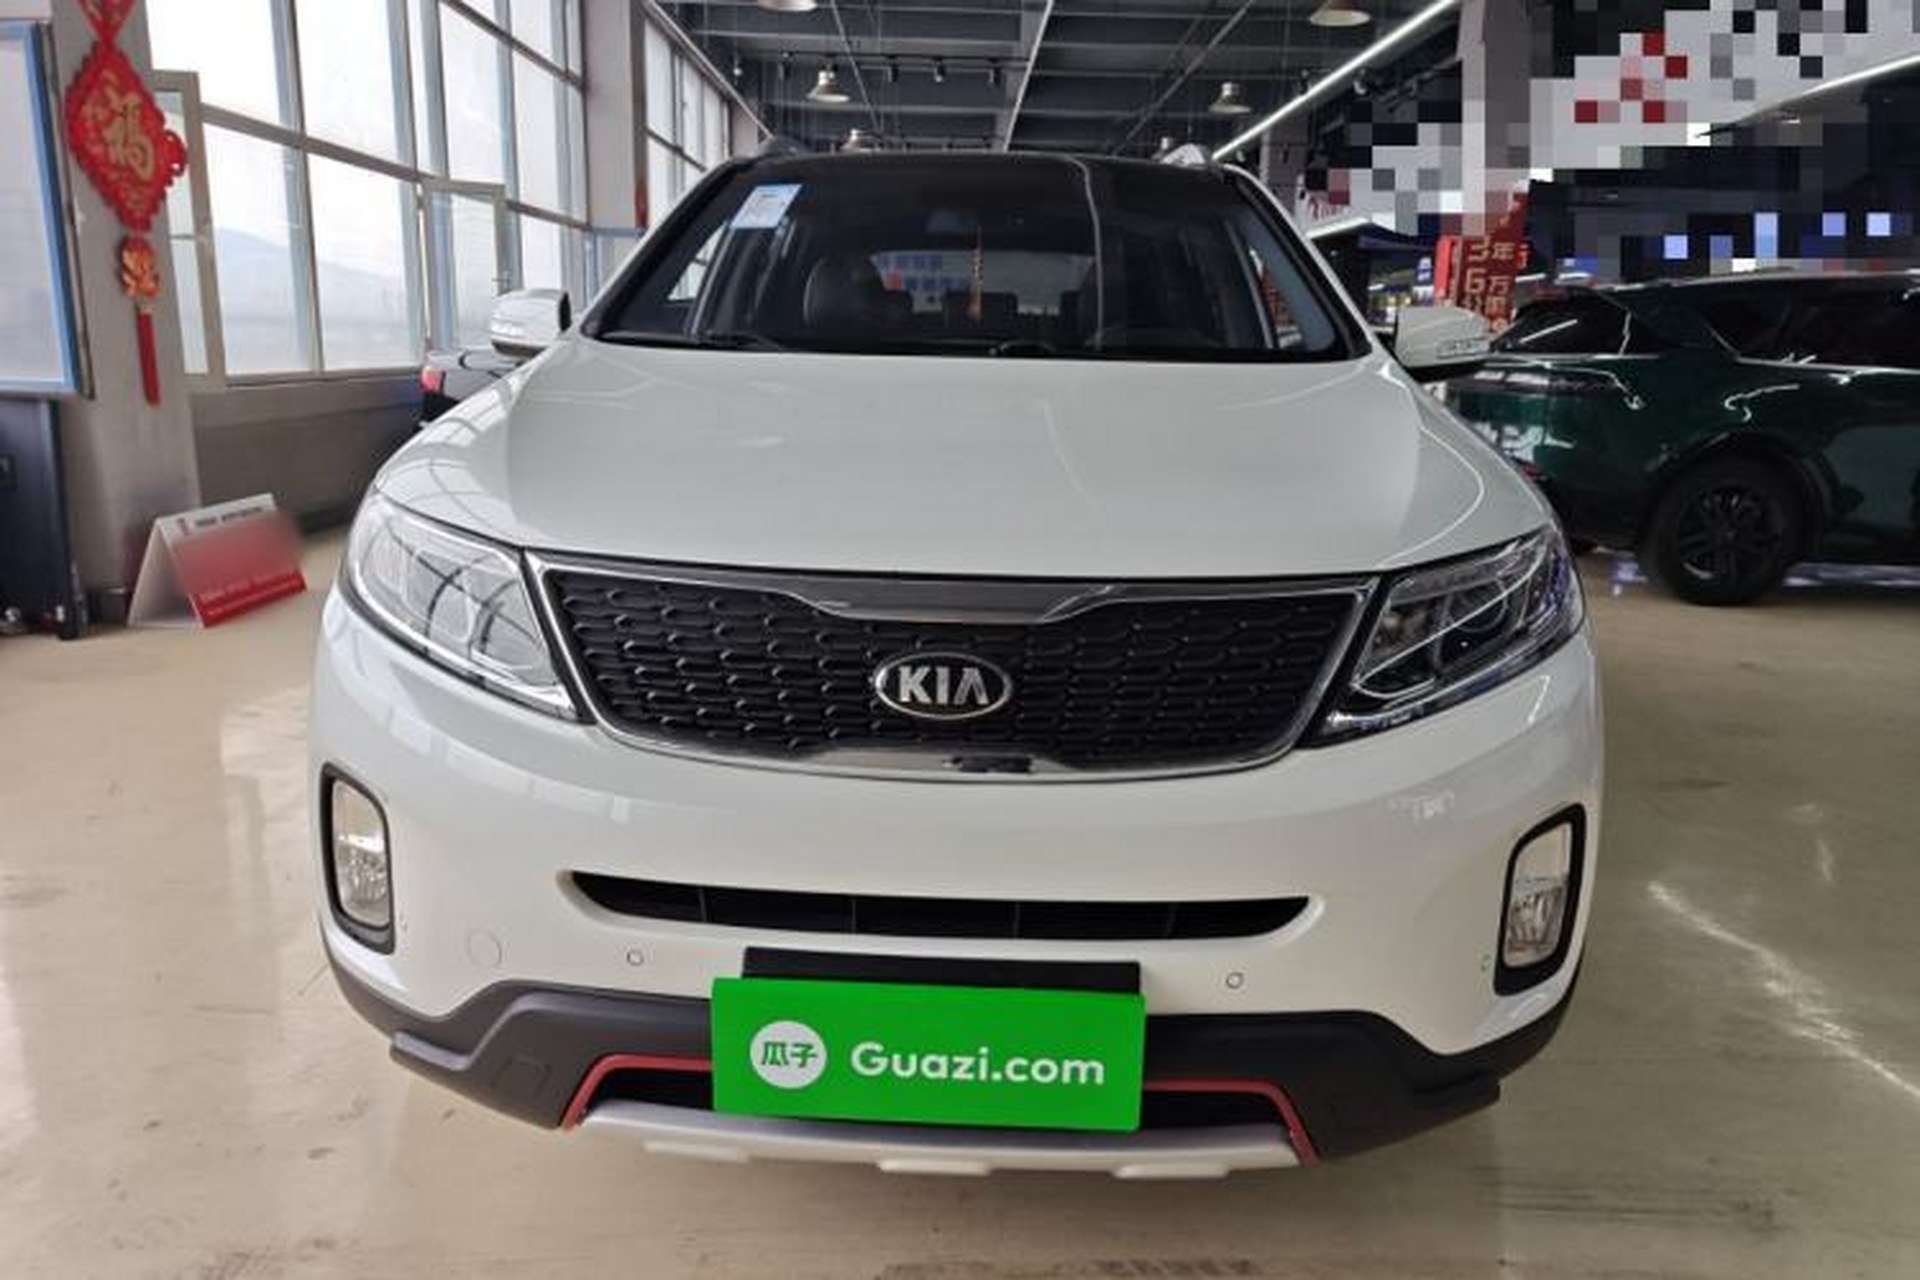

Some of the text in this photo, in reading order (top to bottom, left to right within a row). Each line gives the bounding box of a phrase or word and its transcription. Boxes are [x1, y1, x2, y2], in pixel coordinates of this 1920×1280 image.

[899, 666, 989, 704] KIA
[761, 1041, 817, 1068] 瓜子
[851, 1041, 1105, 1084] Guazi.com
